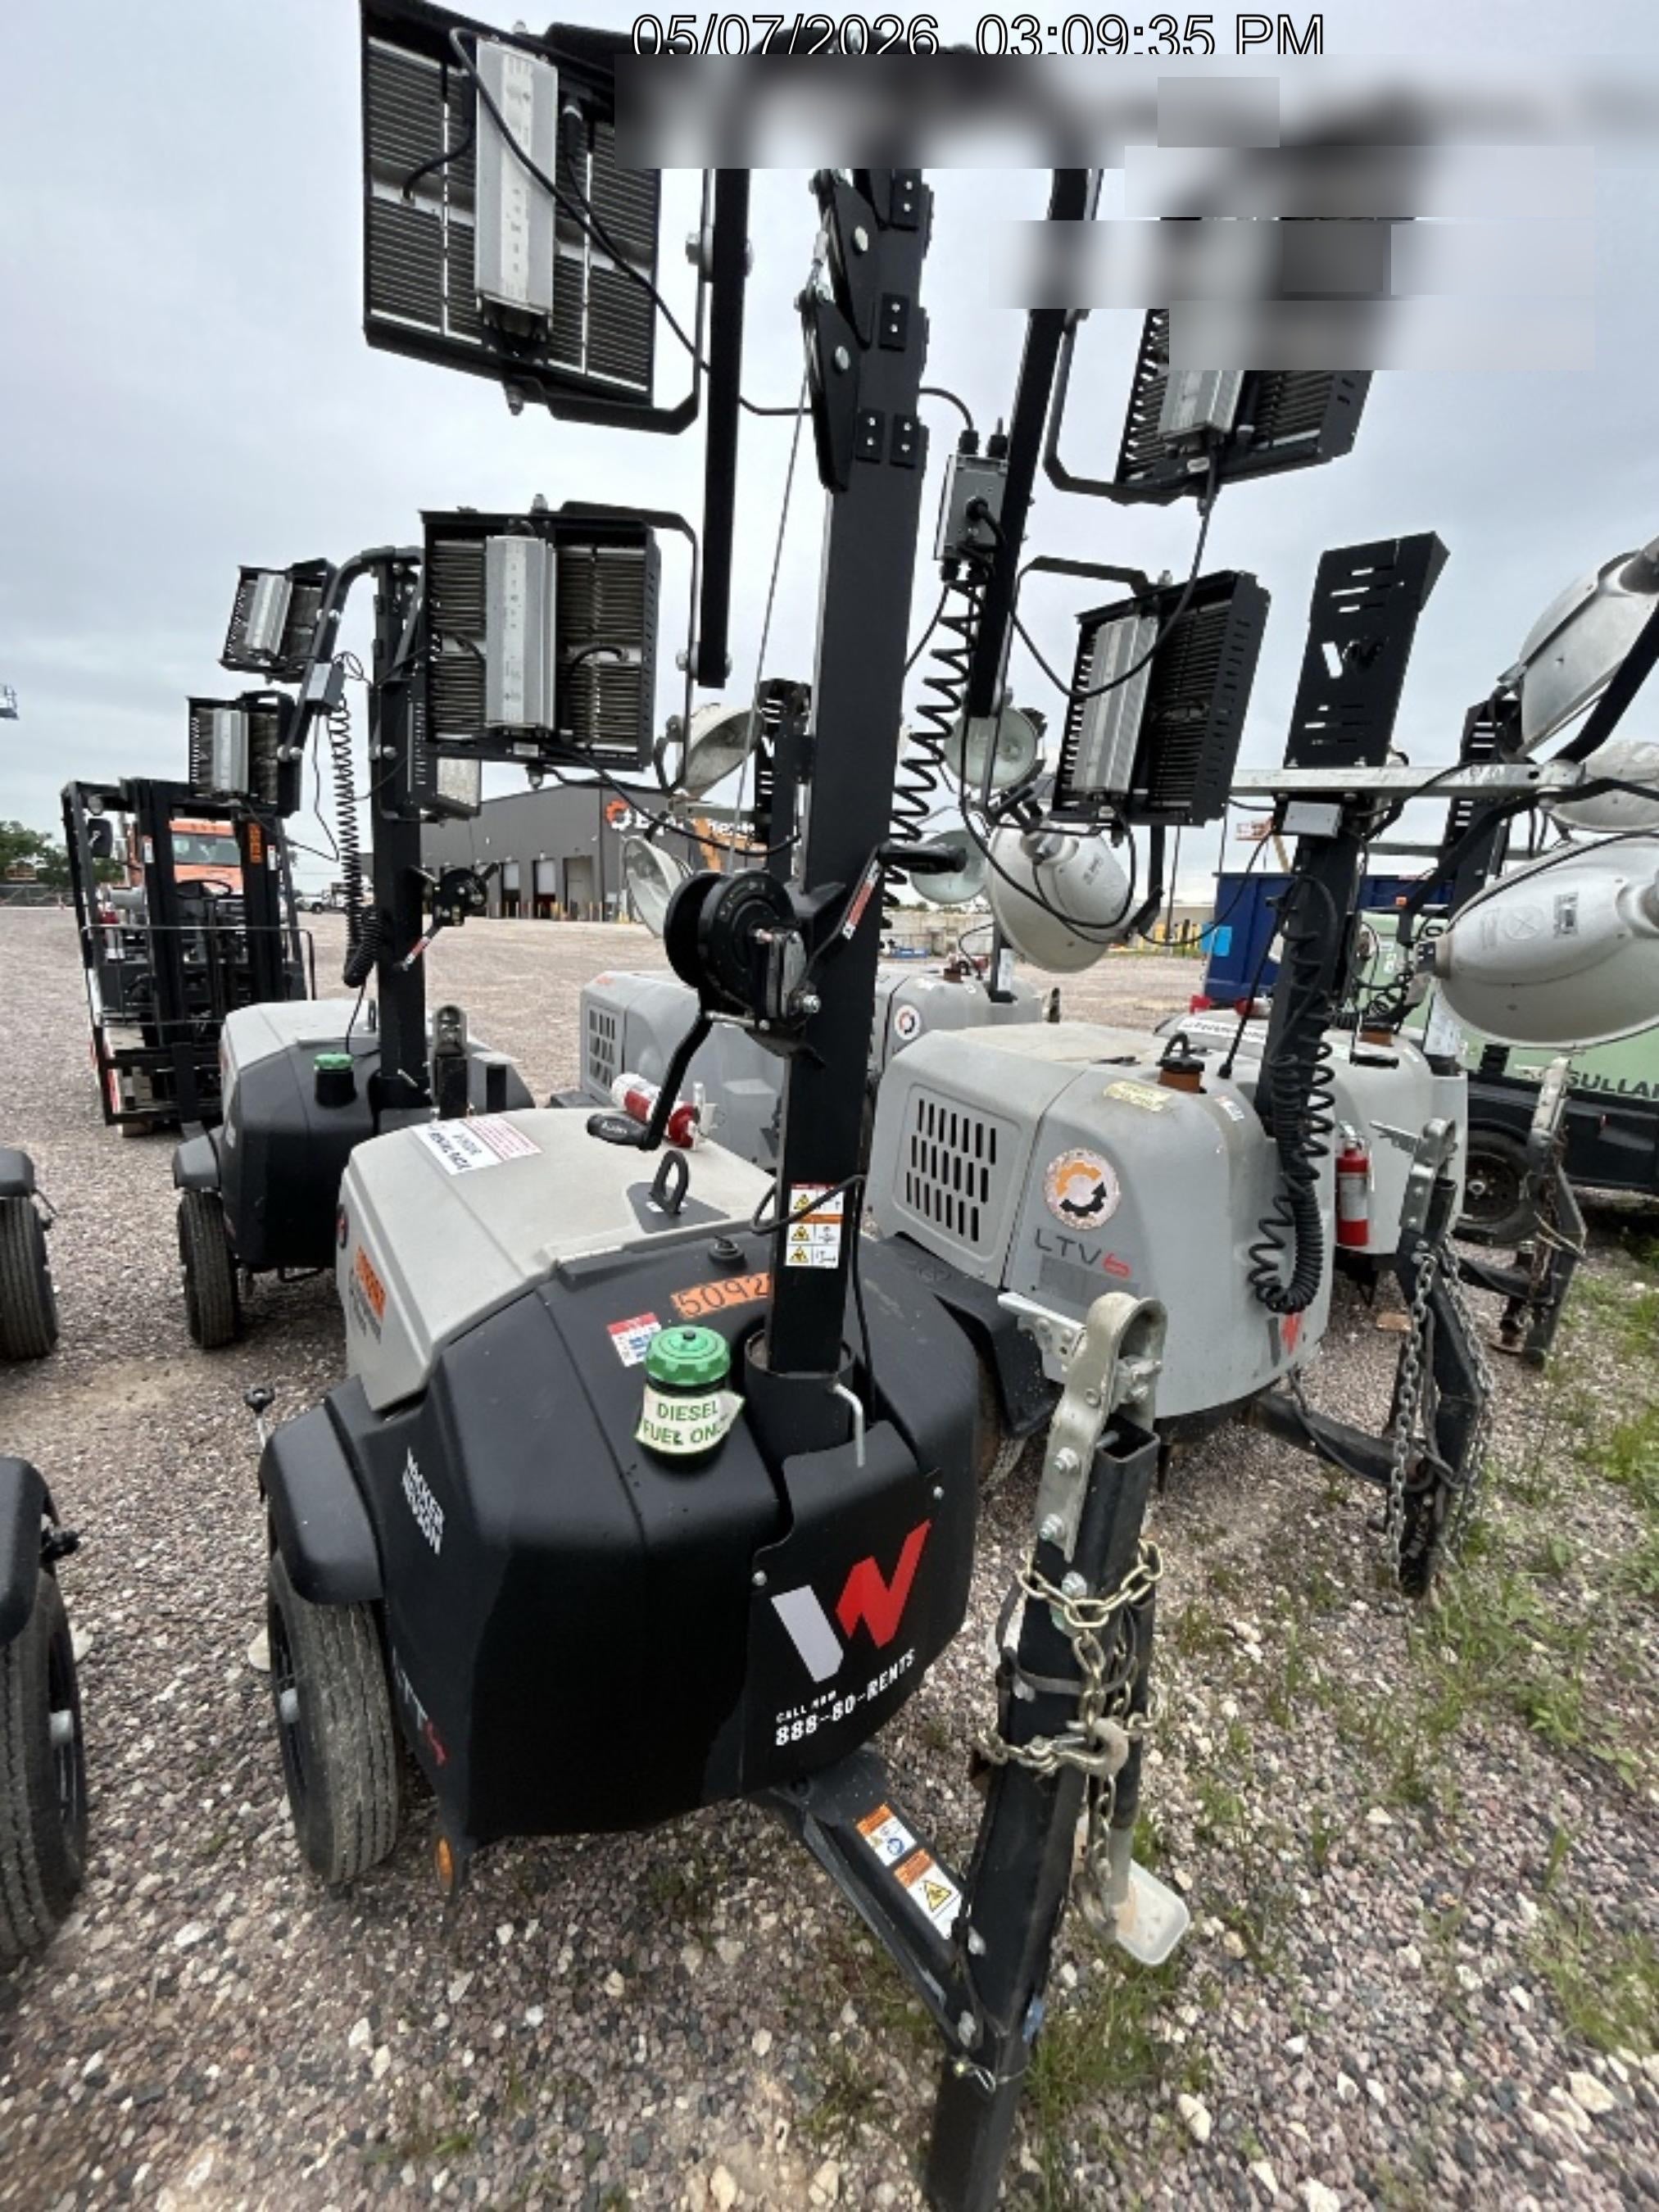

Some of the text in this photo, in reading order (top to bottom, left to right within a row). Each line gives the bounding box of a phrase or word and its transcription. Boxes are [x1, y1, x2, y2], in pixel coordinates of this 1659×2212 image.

[1035, 1228, 1130, 1277] LTV6
[657, 1401, 718, 1421] DIESEL
[643, 1415, 728, 1445] FUEL ON
[776, 1648, 915, 1746] 888-80-RENTS
[777, 1705, 807, 1724] CALL
